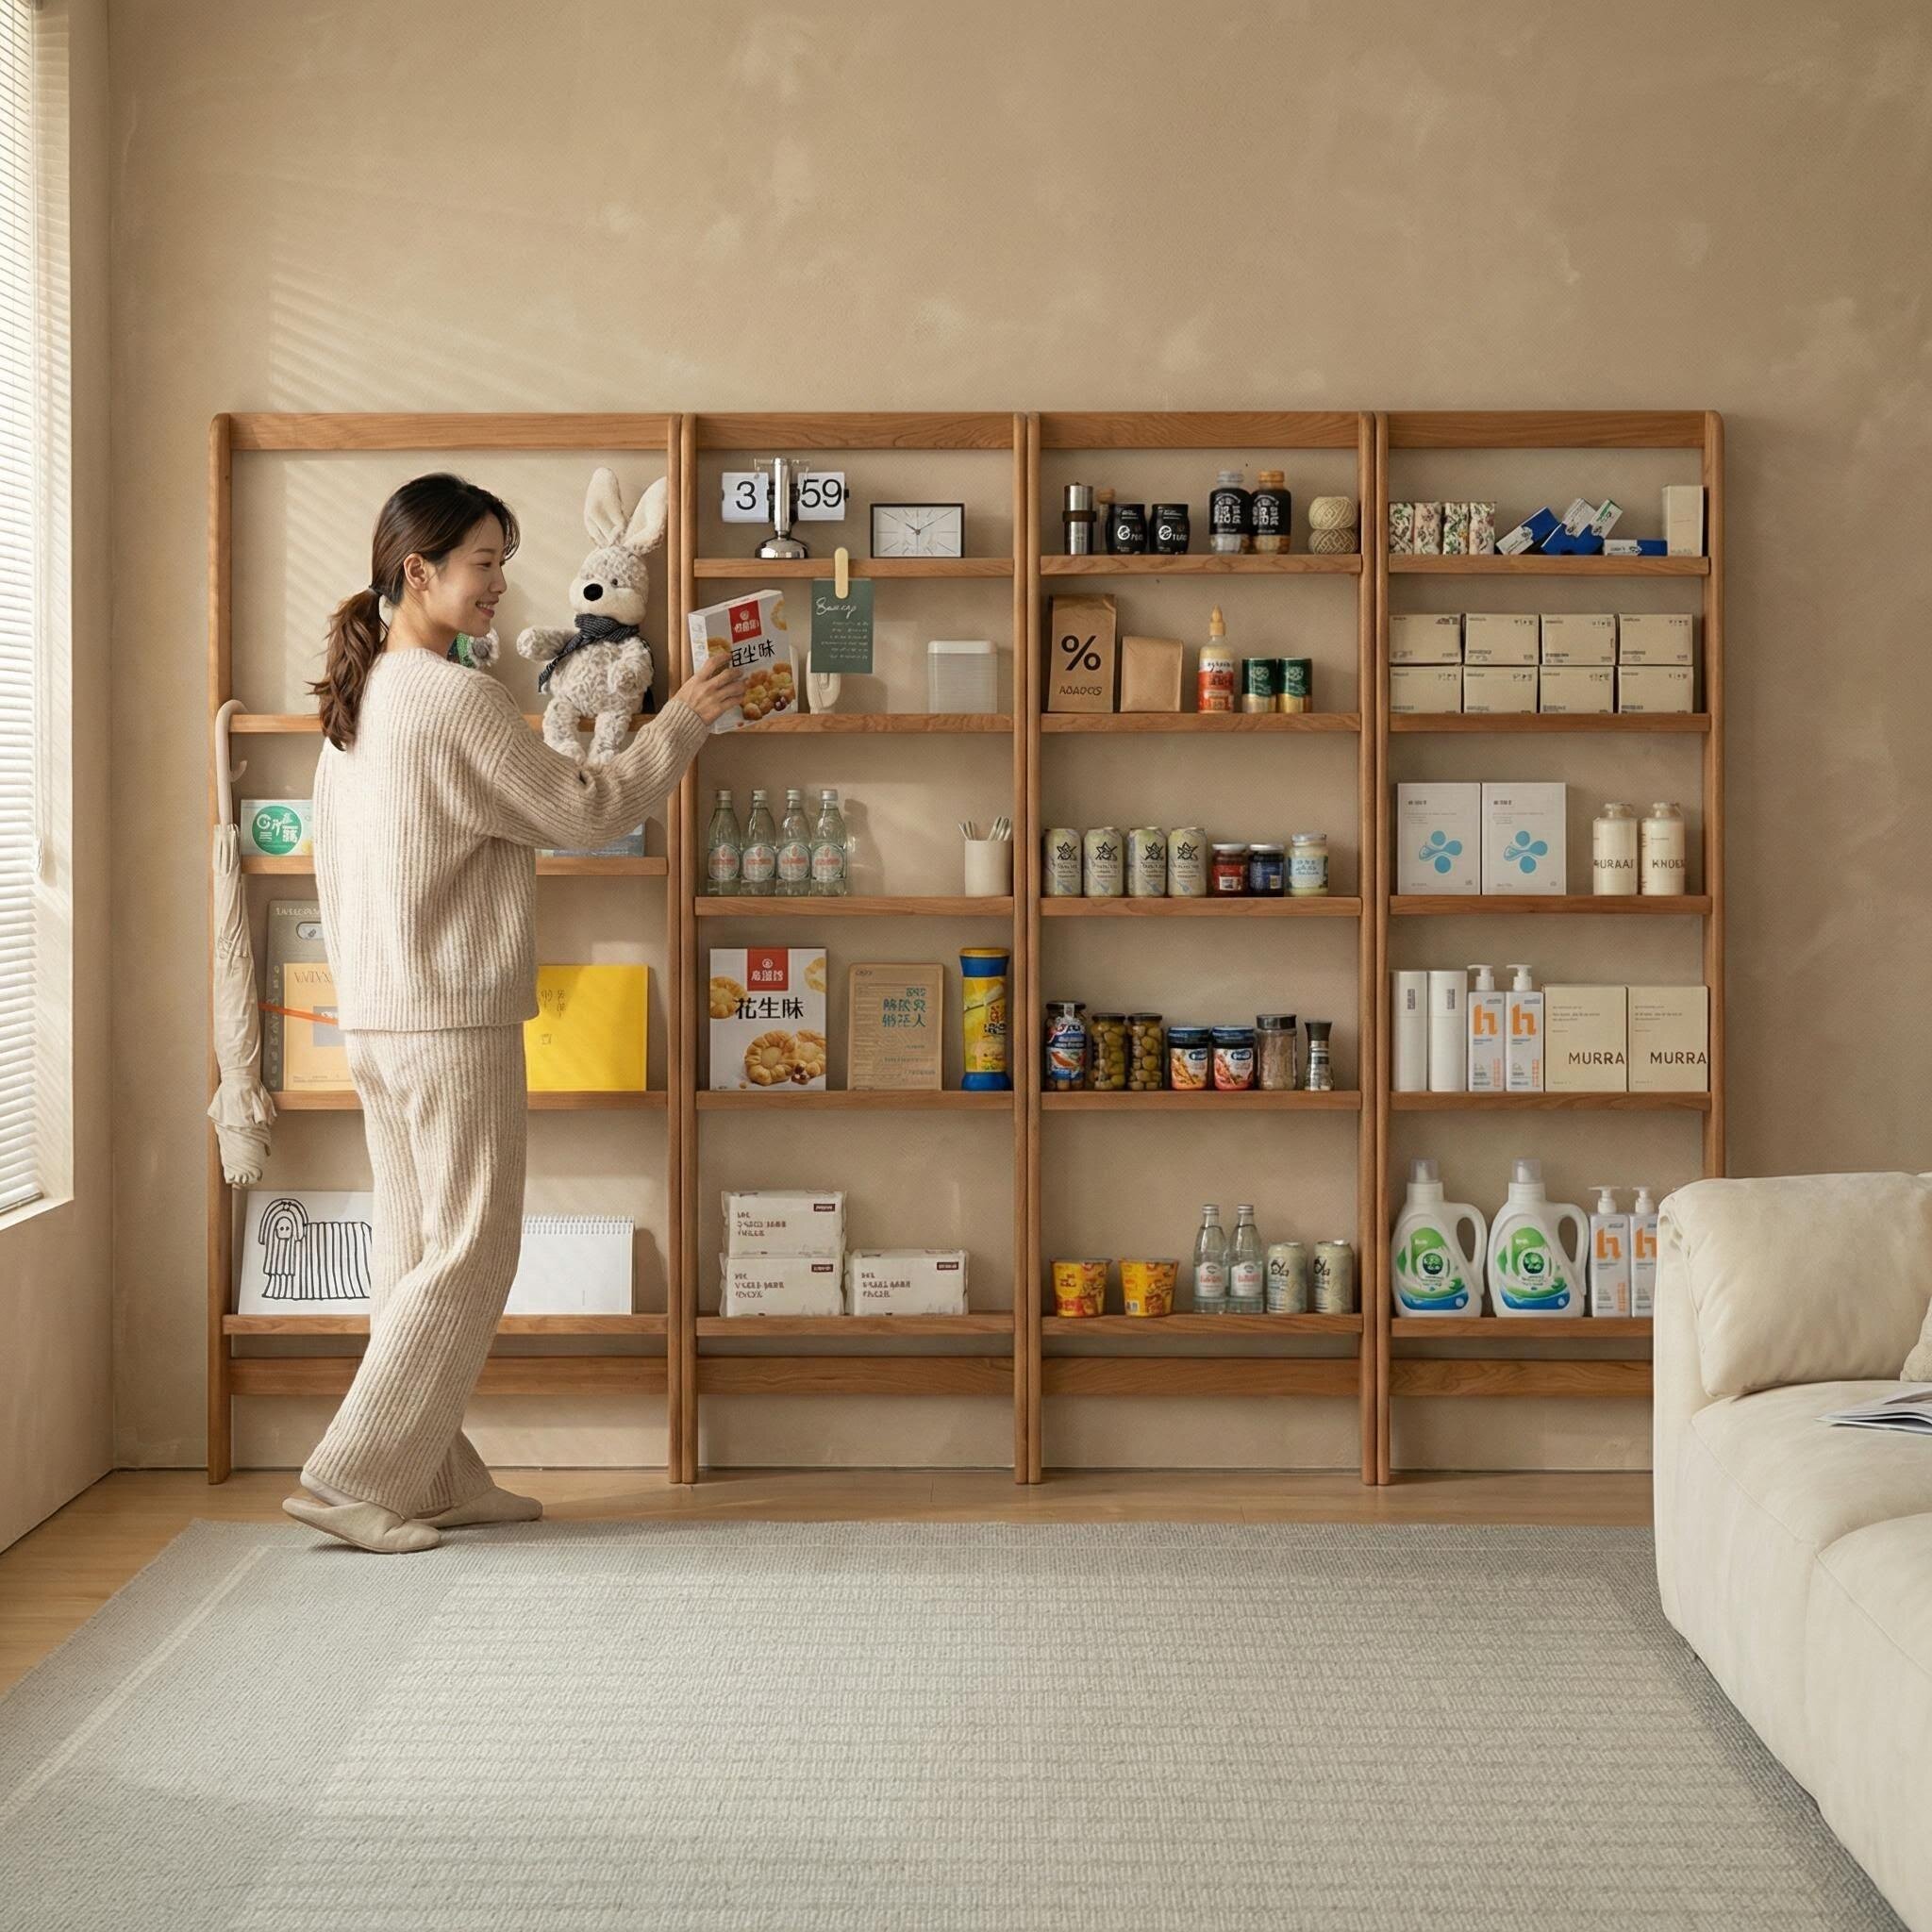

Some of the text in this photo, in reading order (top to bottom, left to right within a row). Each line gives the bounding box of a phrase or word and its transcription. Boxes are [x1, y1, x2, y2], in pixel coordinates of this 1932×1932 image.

[736, 480, 757, 510] 3
[801, 479, 842, 508] 59
[733, 996, 804, 1020] 花生味
[1568, 1052, 1625, 1065] MURRA
[1650, 1051, 1707, 1064] MURRA
